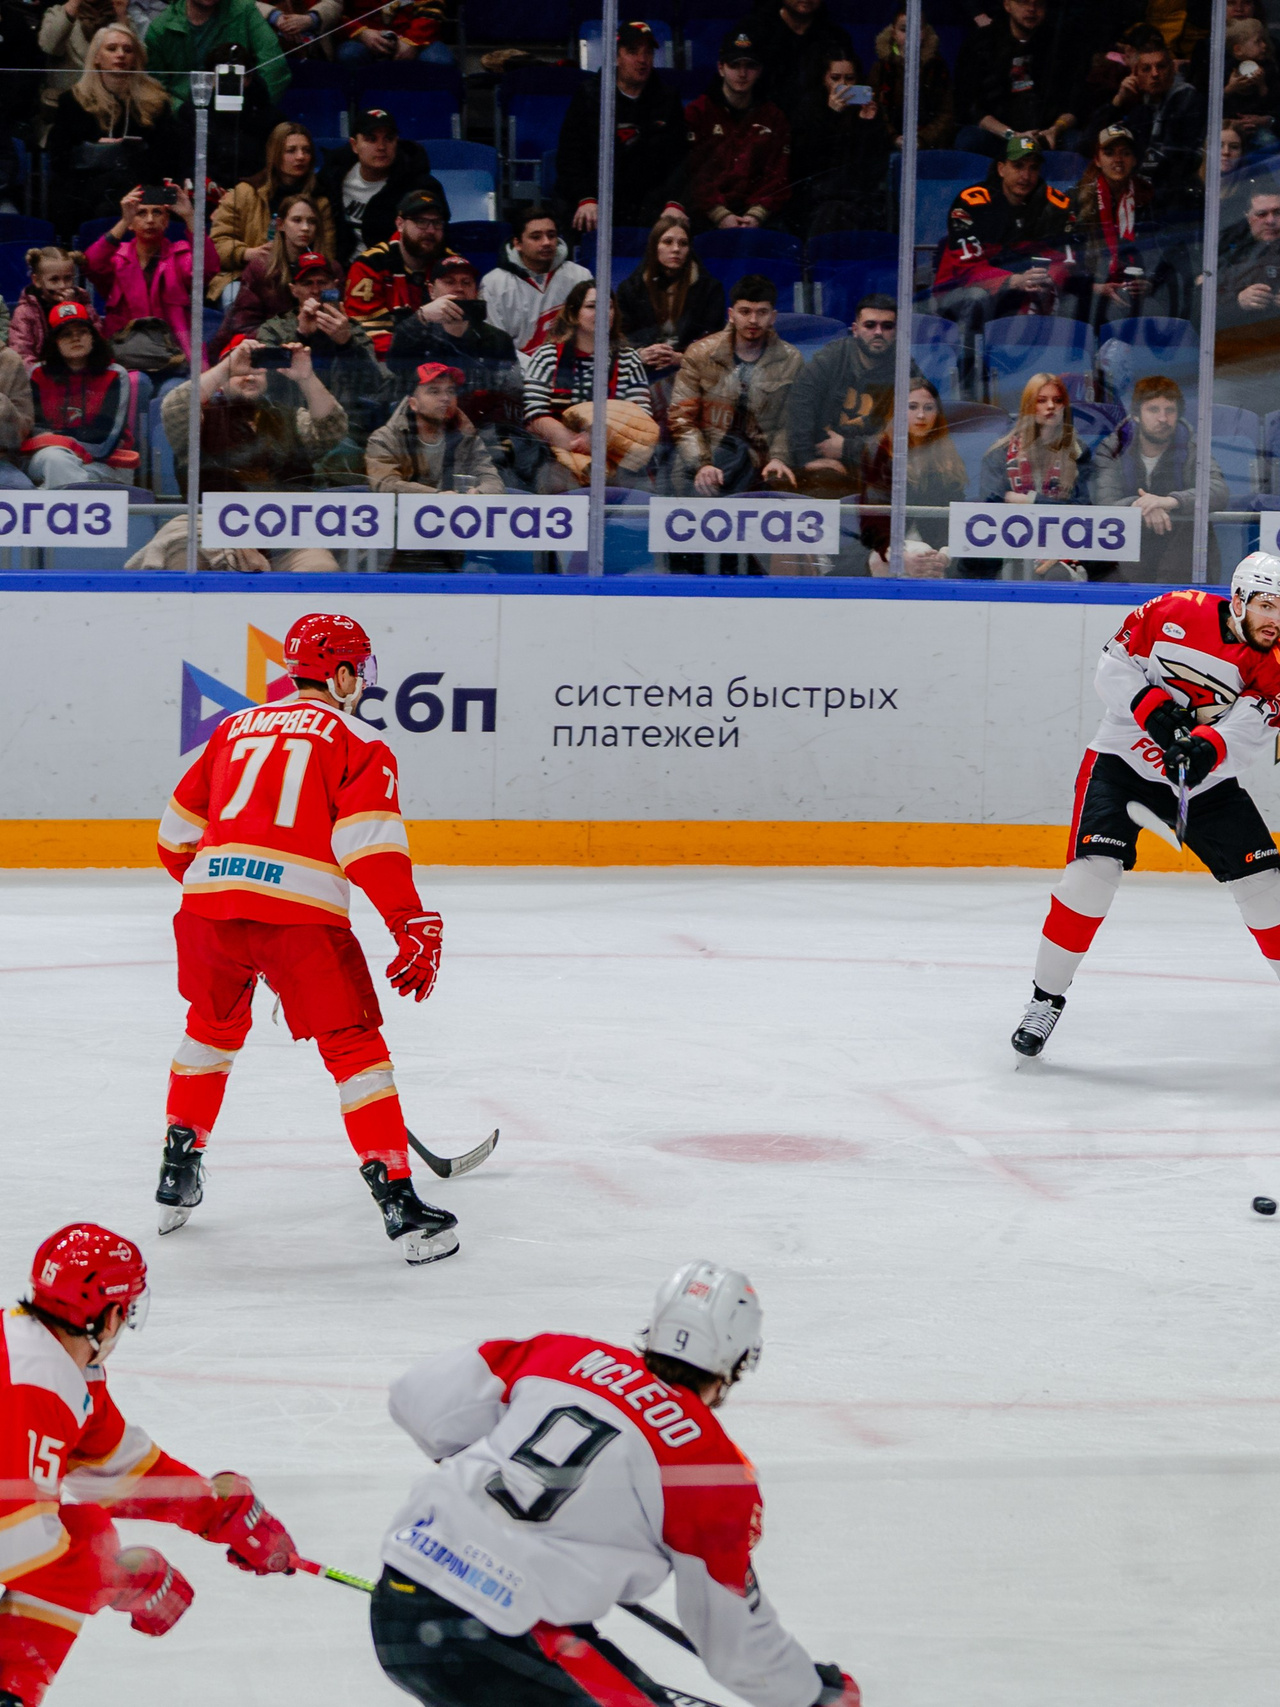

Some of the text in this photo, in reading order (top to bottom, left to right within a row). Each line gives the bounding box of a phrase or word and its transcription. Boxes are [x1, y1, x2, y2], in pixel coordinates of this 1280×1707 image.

[0, 502, 112, 536] огаз
[217, 503, 379, 538] согаз
[413, 504, 573, 539] согаз
[664, 508, 825, 543] согаз
[965, 513, 1126, 550] согаз
[289, 637, 301, 655] 71
[354, 671, 497, 734] сбп
[554, 675, 898, 717] система быстрых
[227, 708, 339, 744] CAMPBELL
[553, 715, 740, 749] платежей
[218, 734, 313, 829] 71
[382, 765, 398, 800] 7
[208, 857, 285, 885] SIBUR
[41, 1258, 60, 1286] 15
[672, 1328, 690, 1353] 9
[567, 1348, 703, 1449] MCLEOD
[27, 1428, 66, 1496] 15
[484, 1404, 624, 1523] 9
